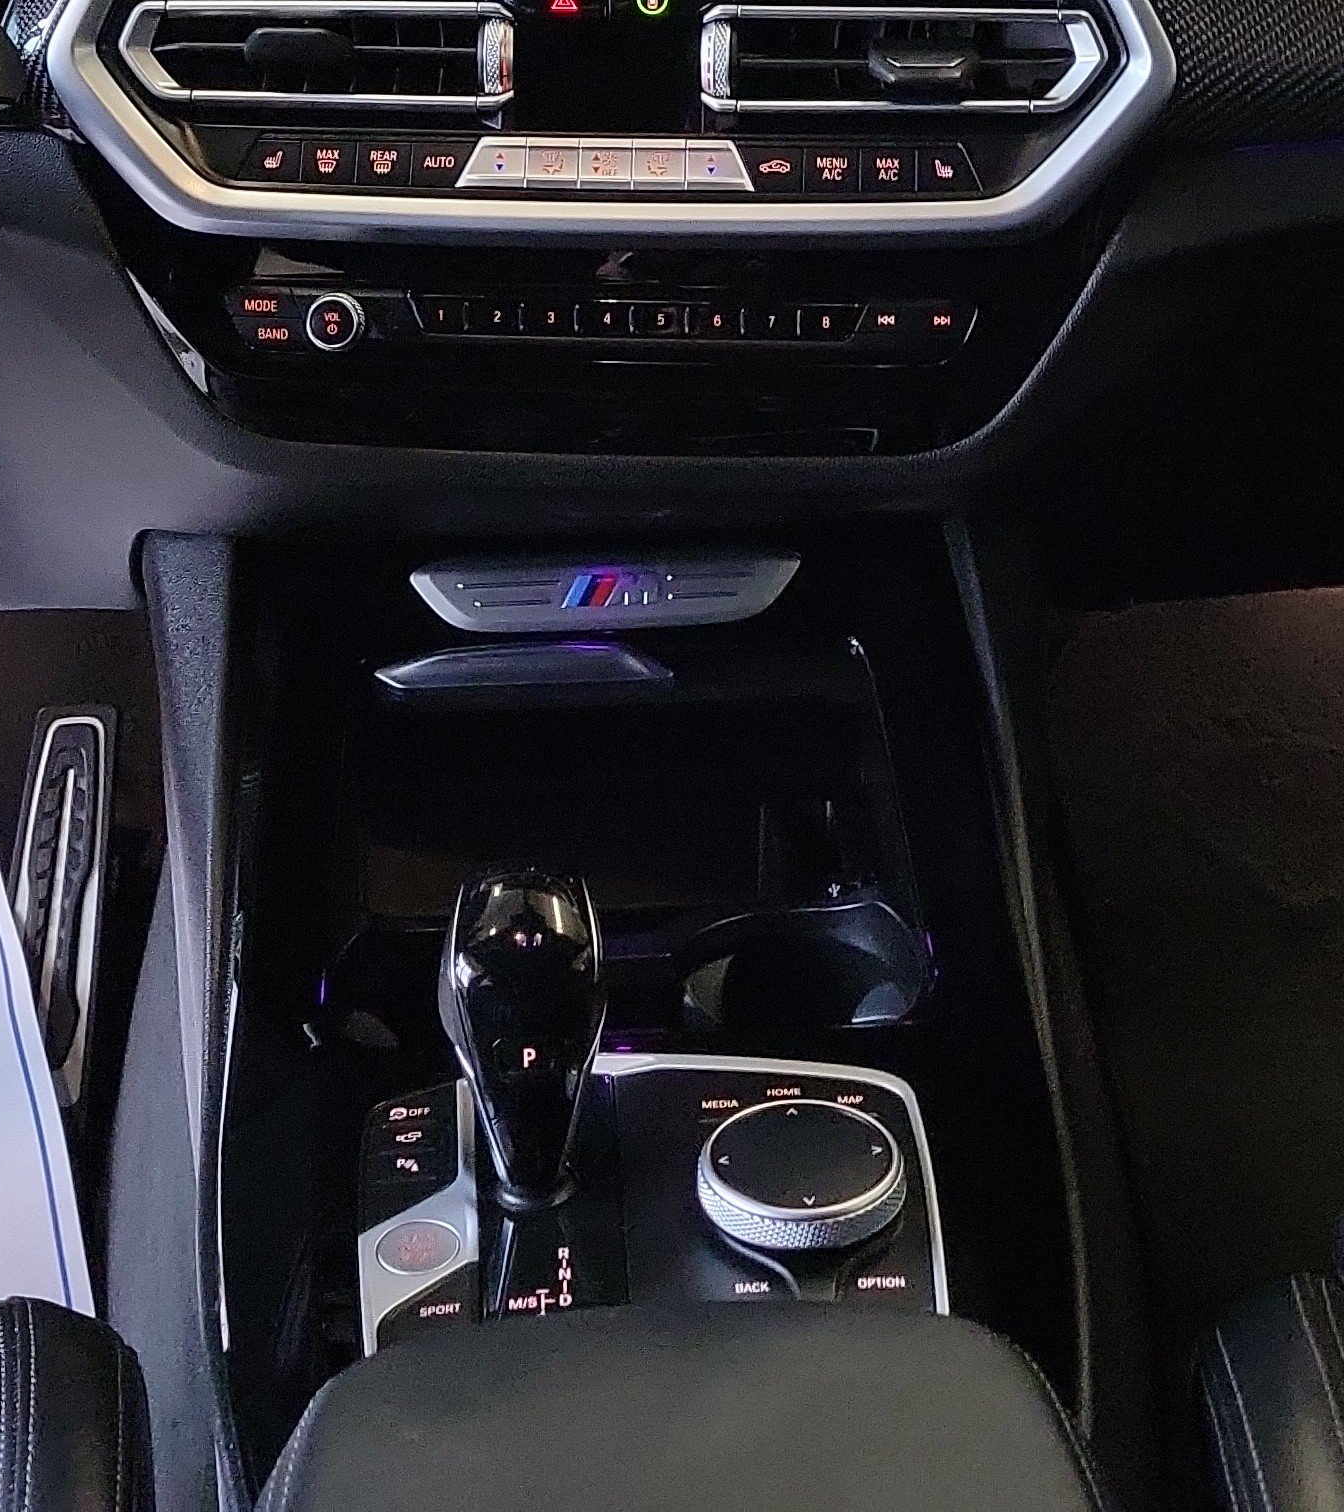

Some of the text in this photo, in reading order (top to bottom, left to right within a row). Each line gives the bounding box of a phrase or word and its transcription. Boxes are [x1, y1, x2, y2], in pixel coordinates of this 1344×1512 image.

[316, 148, 341, 161] MAX
[370, 150, 398, 162] REAR
[423, 154, 455, 169] AUTO
[816, 156, 848, 169] MENU
[876, 157, 900, 169] MAX
[821, 168, 843, 181] A/C
[878, 169, 899, 182] A/C
[244, 298, 278, 312] MODE
[324, 312, 341, 322] VOL
[493, 310, 502, 323] 2
[547, 311, 555, 324] 3
[603, 312, 611, 325] 4
[657, 313, 665, 326] 5
[713, 314, 722, 327] 6
[768, 315, 776, 328] 7
[821, 316, 830, 329] 8
[257, 326, 289, 341] BAND
[523, 1047, 537, 1068] P
[766, 1087, 802, 1097] HOME
[701, 1098, 739, 1110] MEDIA
[837, 1094, 864, 1105] MAP
[408, 1106, 431, 1117] OFF
[558, 1246, 570, 1259] R
[558, 1267, 572, 1281] N
[734, 1281, 771, 1295] BACK
[857, 1275, 907, 1290] OPTION
[508, 1295, 539, 1311] M/S
[559, 1293, 573, 1307] D
[419, 1302, 462, 1318] SPORT
